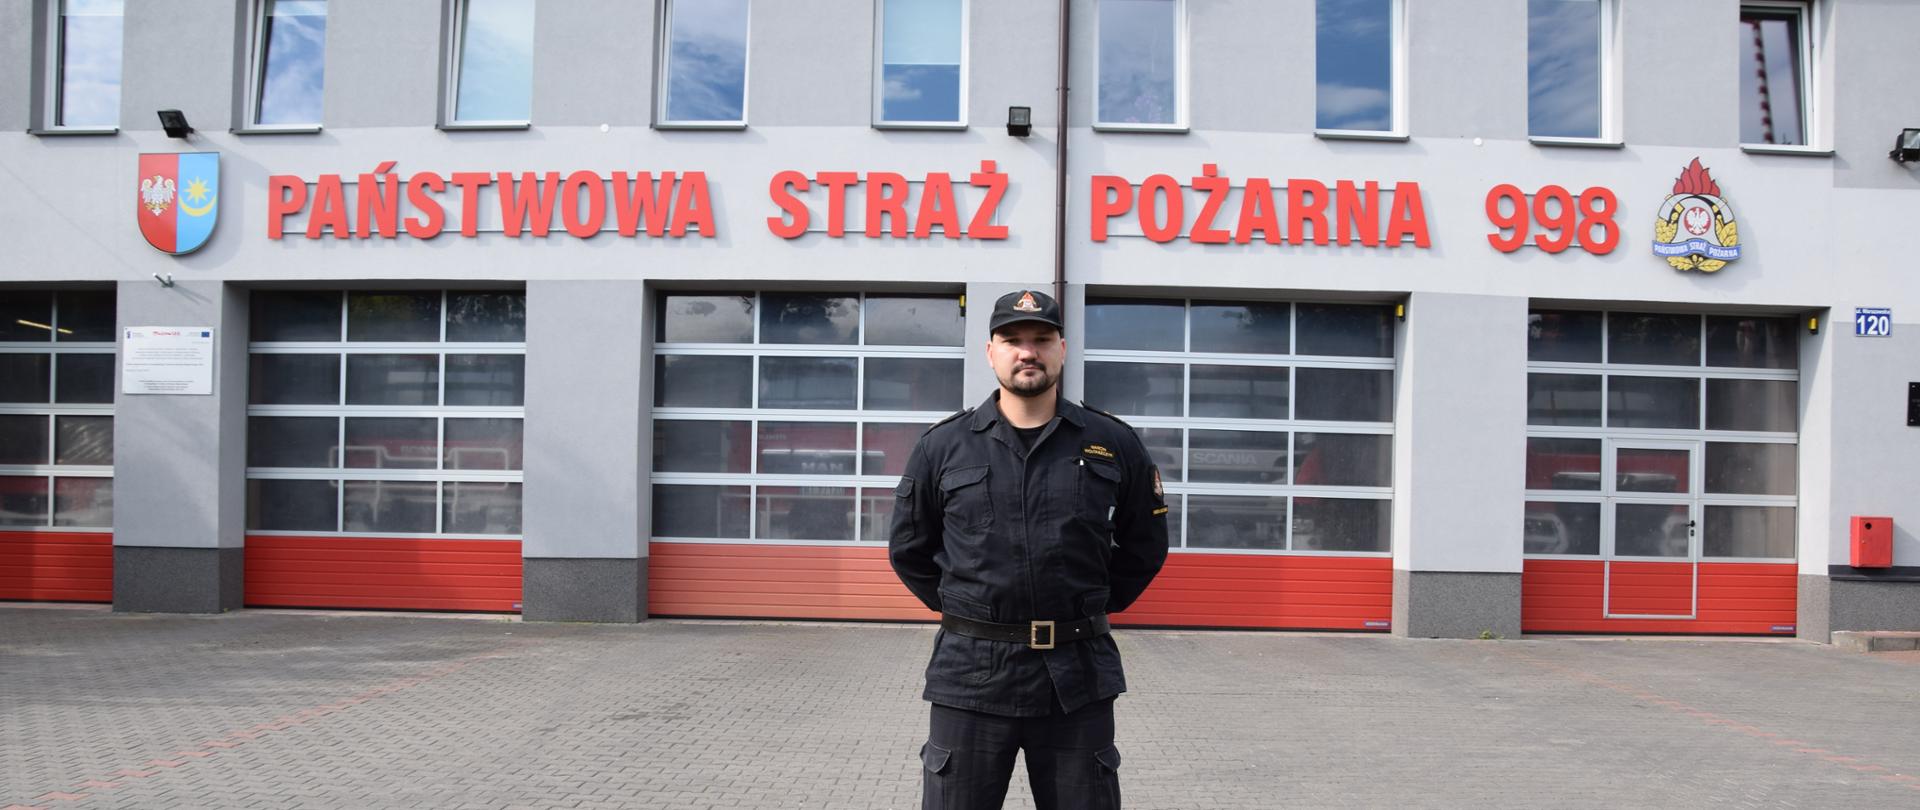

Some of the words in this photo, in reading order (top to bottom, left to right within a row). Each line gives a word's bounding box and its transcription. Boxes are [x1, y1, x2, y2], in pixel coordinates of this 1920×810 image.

[268, 161, 716, 240] PAŃSTWOWA
[766, 159, 1010, 240] STRAŻ
[1090, 163, 1432, 250] POŻARNA
[1485, 183, 1621, 256] 998
[1857, 314, 1889, 336] 120
[1191, 452, 1257, 465] SCANIA
[801, 462, 844, 473] MAN
